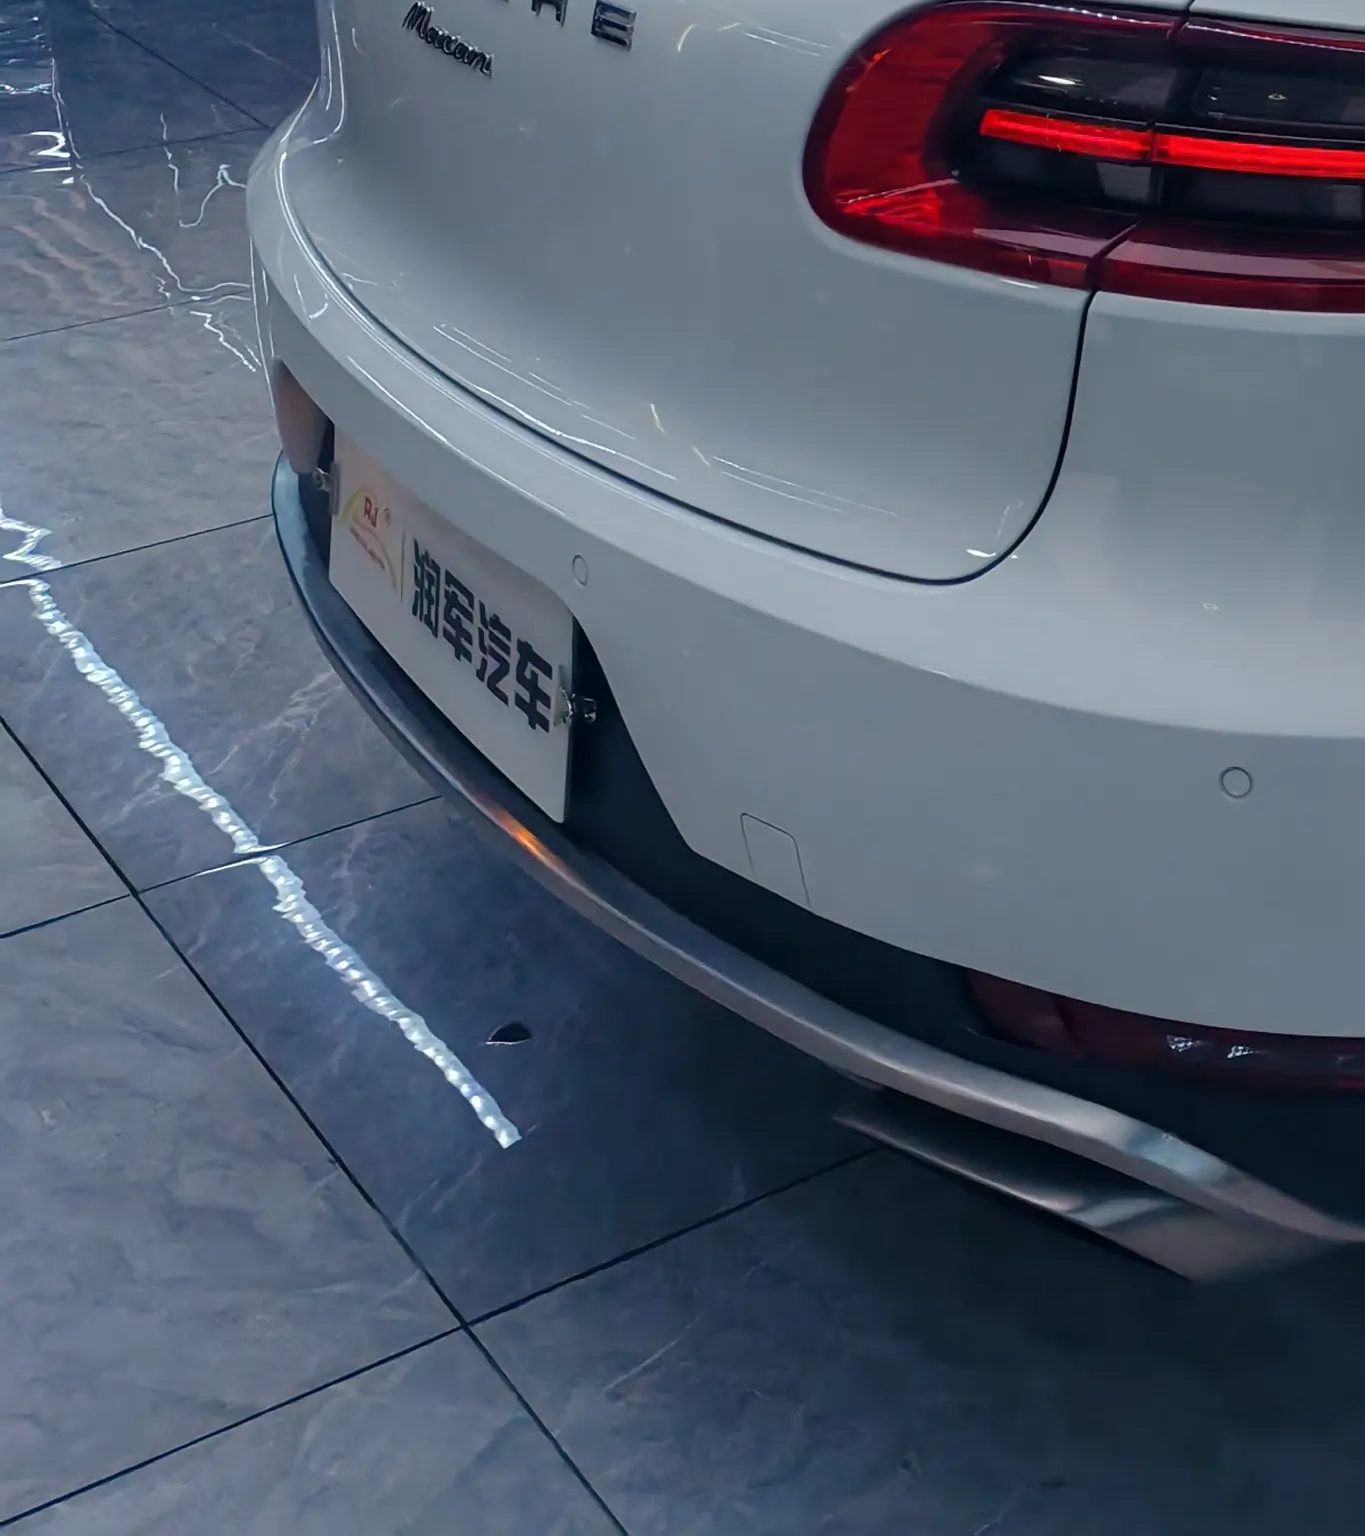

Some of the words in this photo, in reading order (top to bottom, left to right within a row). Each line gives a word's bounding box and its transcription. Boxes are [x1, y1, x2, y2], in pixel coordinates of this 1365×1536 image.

[402, 0, 494, 78] Macan
[411, 537, 553, 734] 润军汽车
